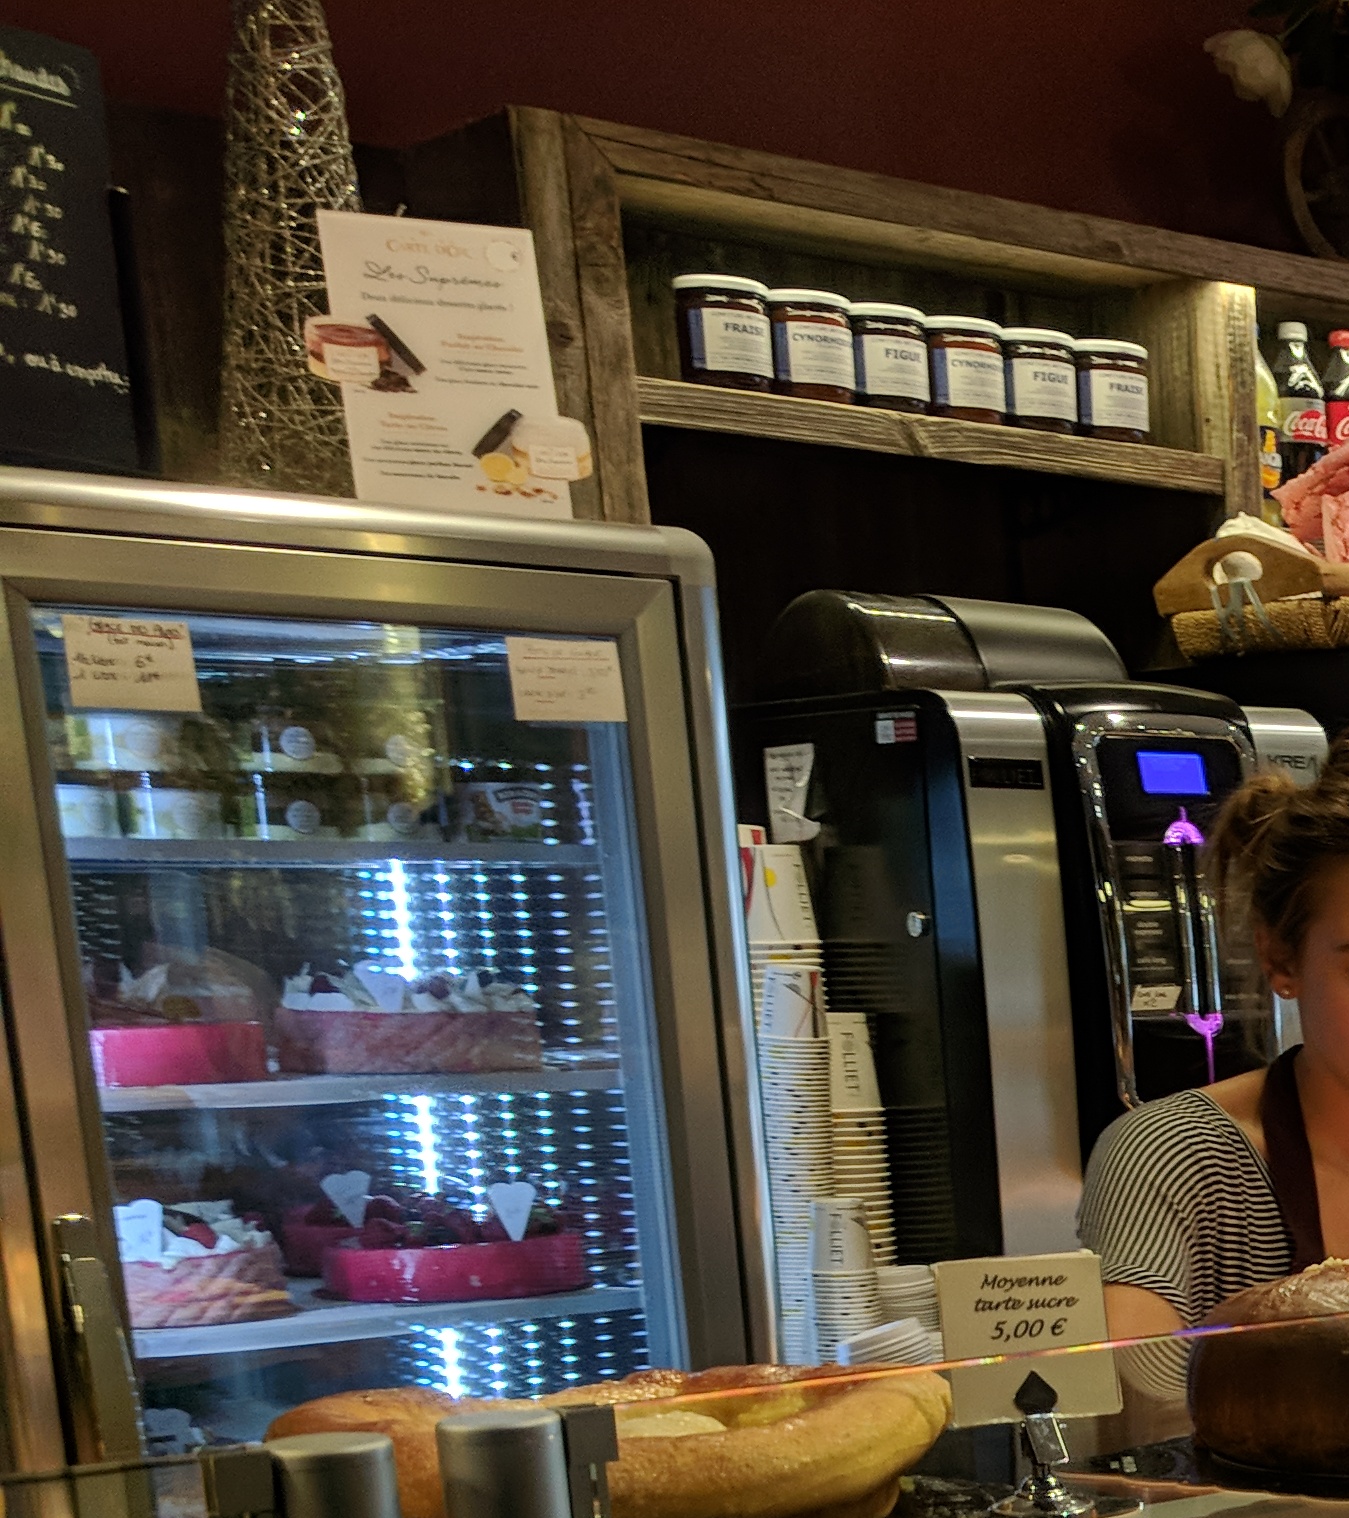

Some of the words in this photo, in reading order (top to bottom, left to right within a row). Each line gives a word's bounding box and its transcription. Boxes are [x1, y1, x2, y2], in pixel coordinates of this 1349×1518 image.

[980, 1273, 1068, 1293] Moyenne
[974, 1297, 1025, 1313] tarte
[1026, 1294, 1080, 1311] sucre
[991, 1319, 1044, 1342] 5,00
[1051, 1317, 1068, 1336] €
